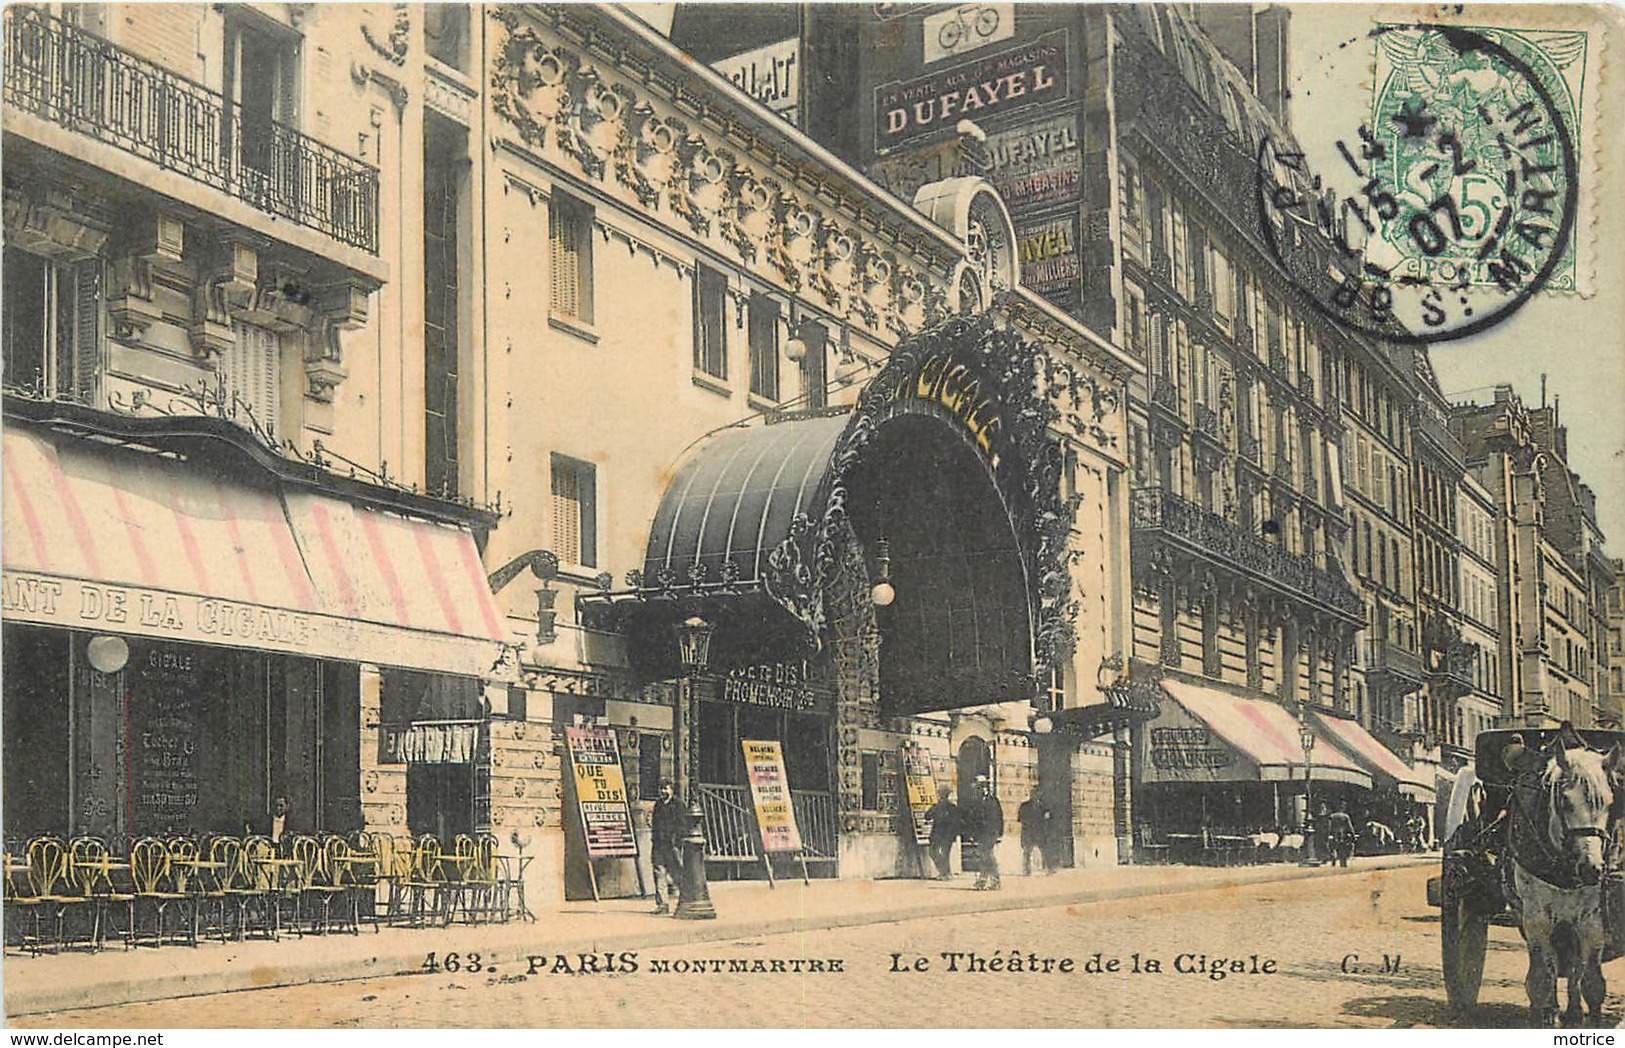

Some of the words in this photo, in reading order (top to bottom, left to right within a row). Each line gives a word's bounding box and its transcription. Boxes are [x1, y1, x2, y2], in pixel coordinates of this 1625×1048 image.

[887, 65, 1054, 134] DUFAYEL
[1408, 194, 1463, 256] 07
[80, 585, 128, 624] DE
[140, 593, 184, 631] LA
[197, 596, 311, 646] CIGALE
[577, 764, 604, 779] QUE
[592, 778, 607, 790] TU
[597, 788, 625, 801] DIS!
